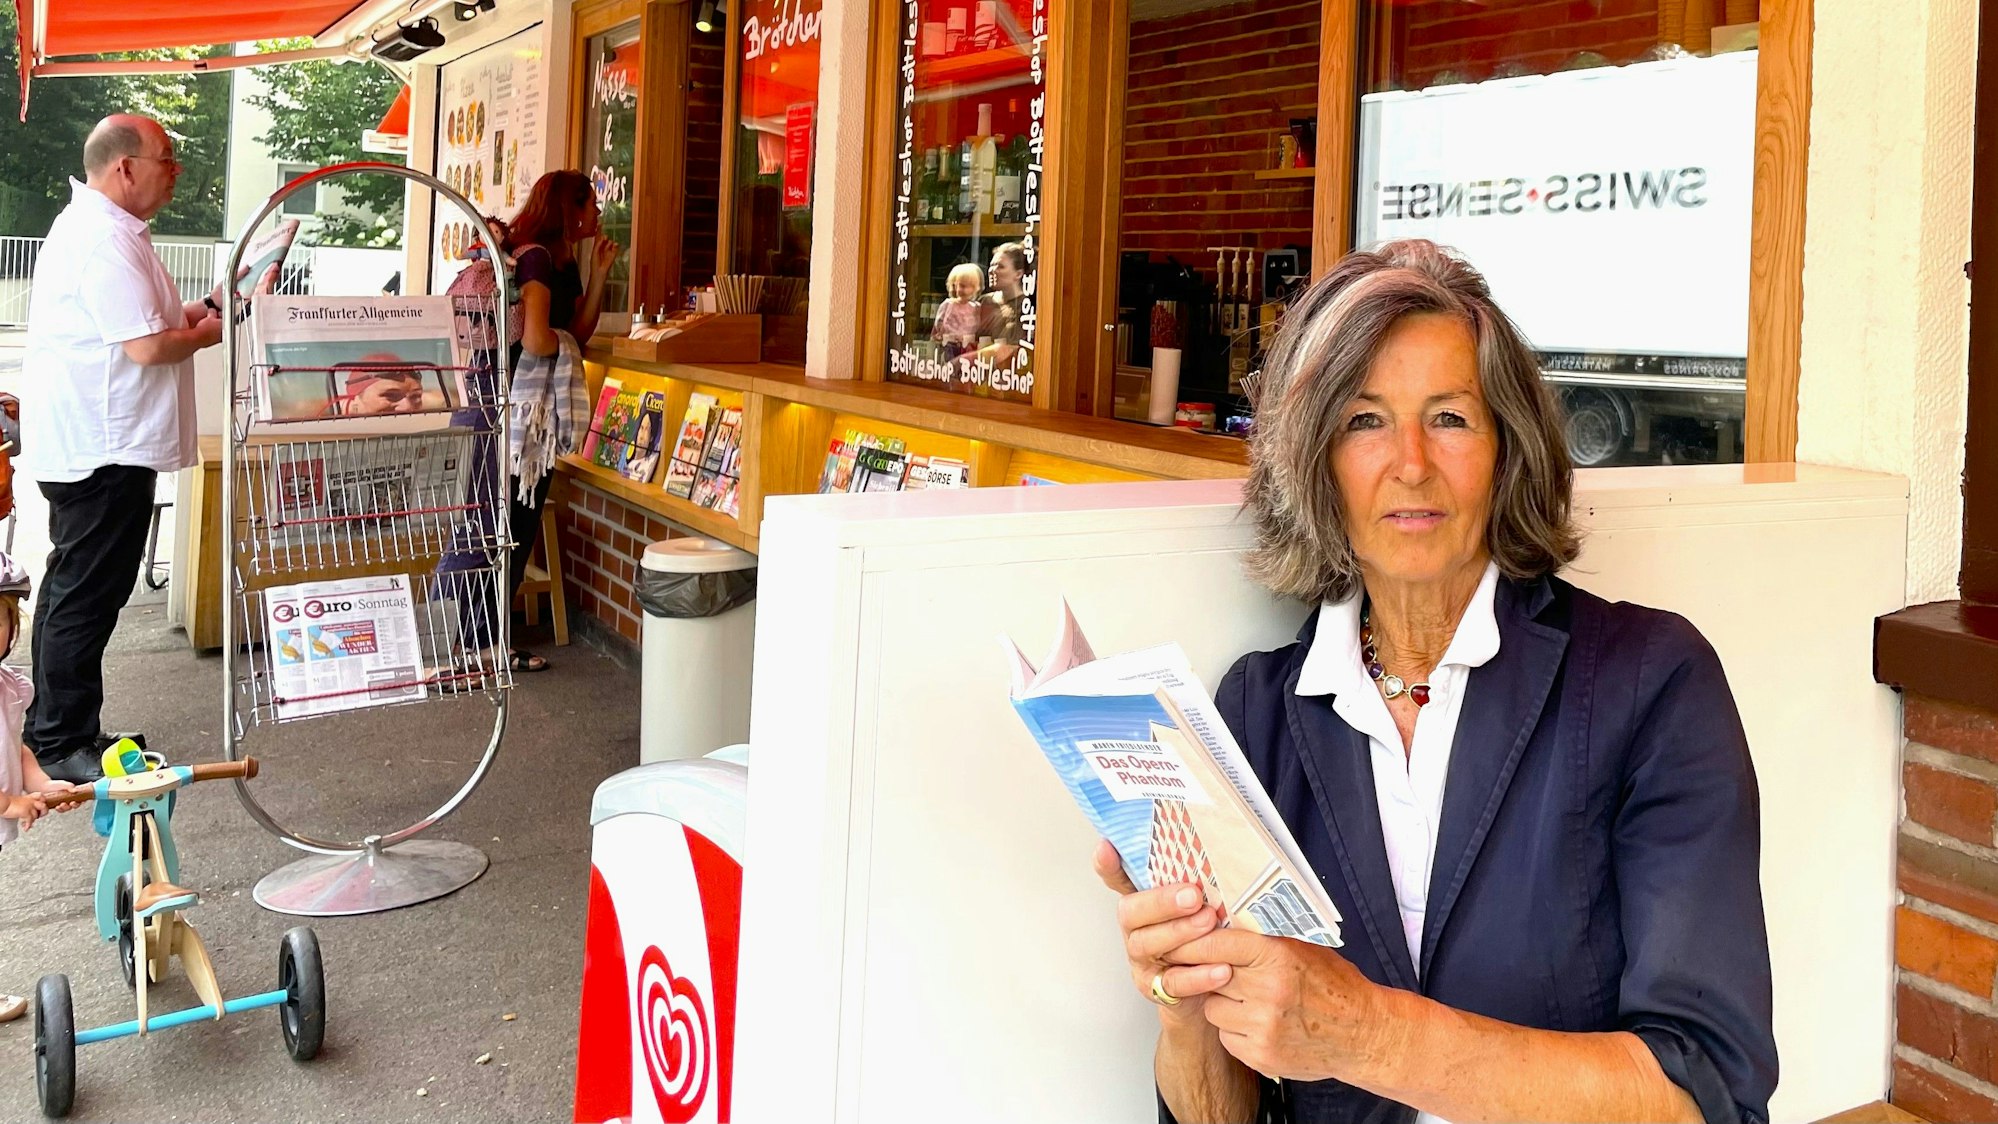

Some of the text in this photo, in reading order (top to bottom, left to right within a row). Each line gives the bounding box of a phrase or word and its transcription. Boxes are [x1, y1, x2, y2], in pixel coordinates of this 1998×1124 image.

[902, 0, 918, 108] Bottles
[592, 52, 627, 108] Nüsse
[604, 113, 613, 151] &
[896, 115, 914, 265] Bottleshop
[1023, 92, 1045, 264] Bottleshop
[287, 305, 423, 323] Frankfurter Allgemeine
[892, 275, 907, 337] shop
[1017, 269, 1037, 370] Bottle
[890, 343, 954, 383] Bottleshop
[960, 351, 1034, 394] Bottleshop
[887, 460, 904, 474] EPO
[358, 597, 408, 609] Sonntag
[1096, 755, 1180, 772] Das Opern-
[1116, 771, 1186, 788] Phantom
